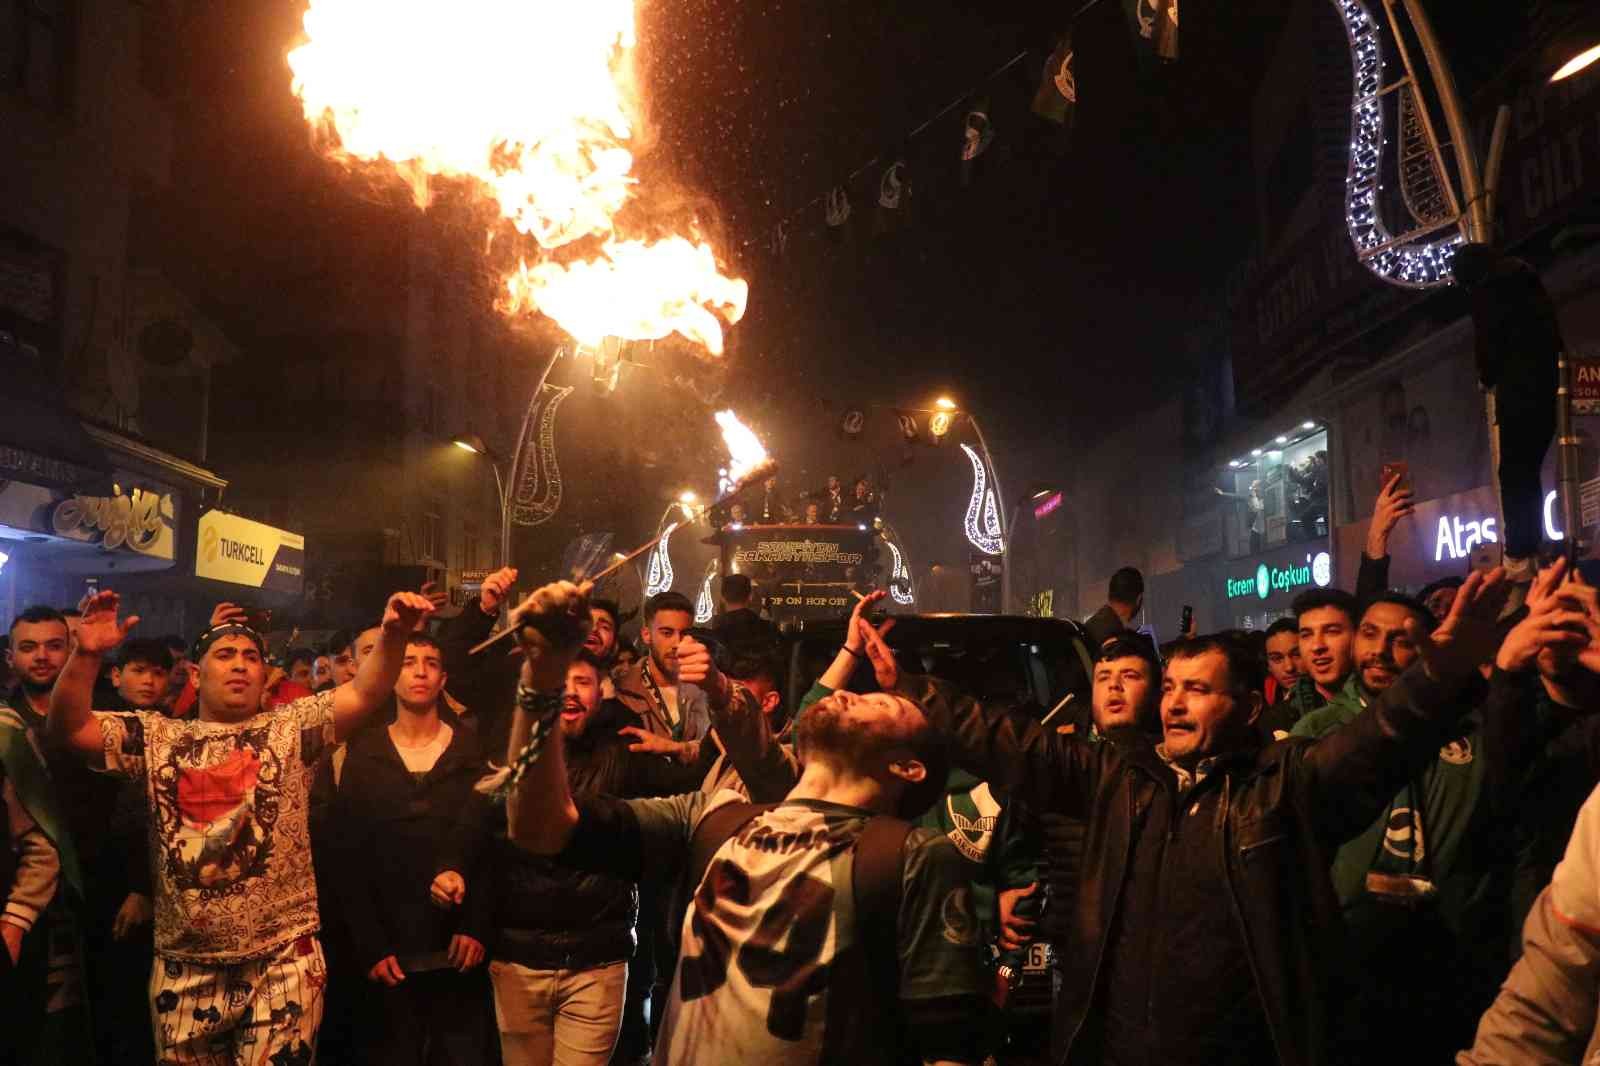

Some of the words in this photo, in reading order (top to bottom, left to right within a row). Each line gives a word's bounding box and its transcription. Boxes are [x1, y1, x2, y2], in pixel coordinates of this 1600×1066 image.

[220, 538, 265, 566] TURKCELL
[1227, 577, 1254, 598] Ekrem
[1271, 563, 1310, 592] Coşkun
[786, 596, 802, 606] ON
[806, 597, 827, 606] HOP
